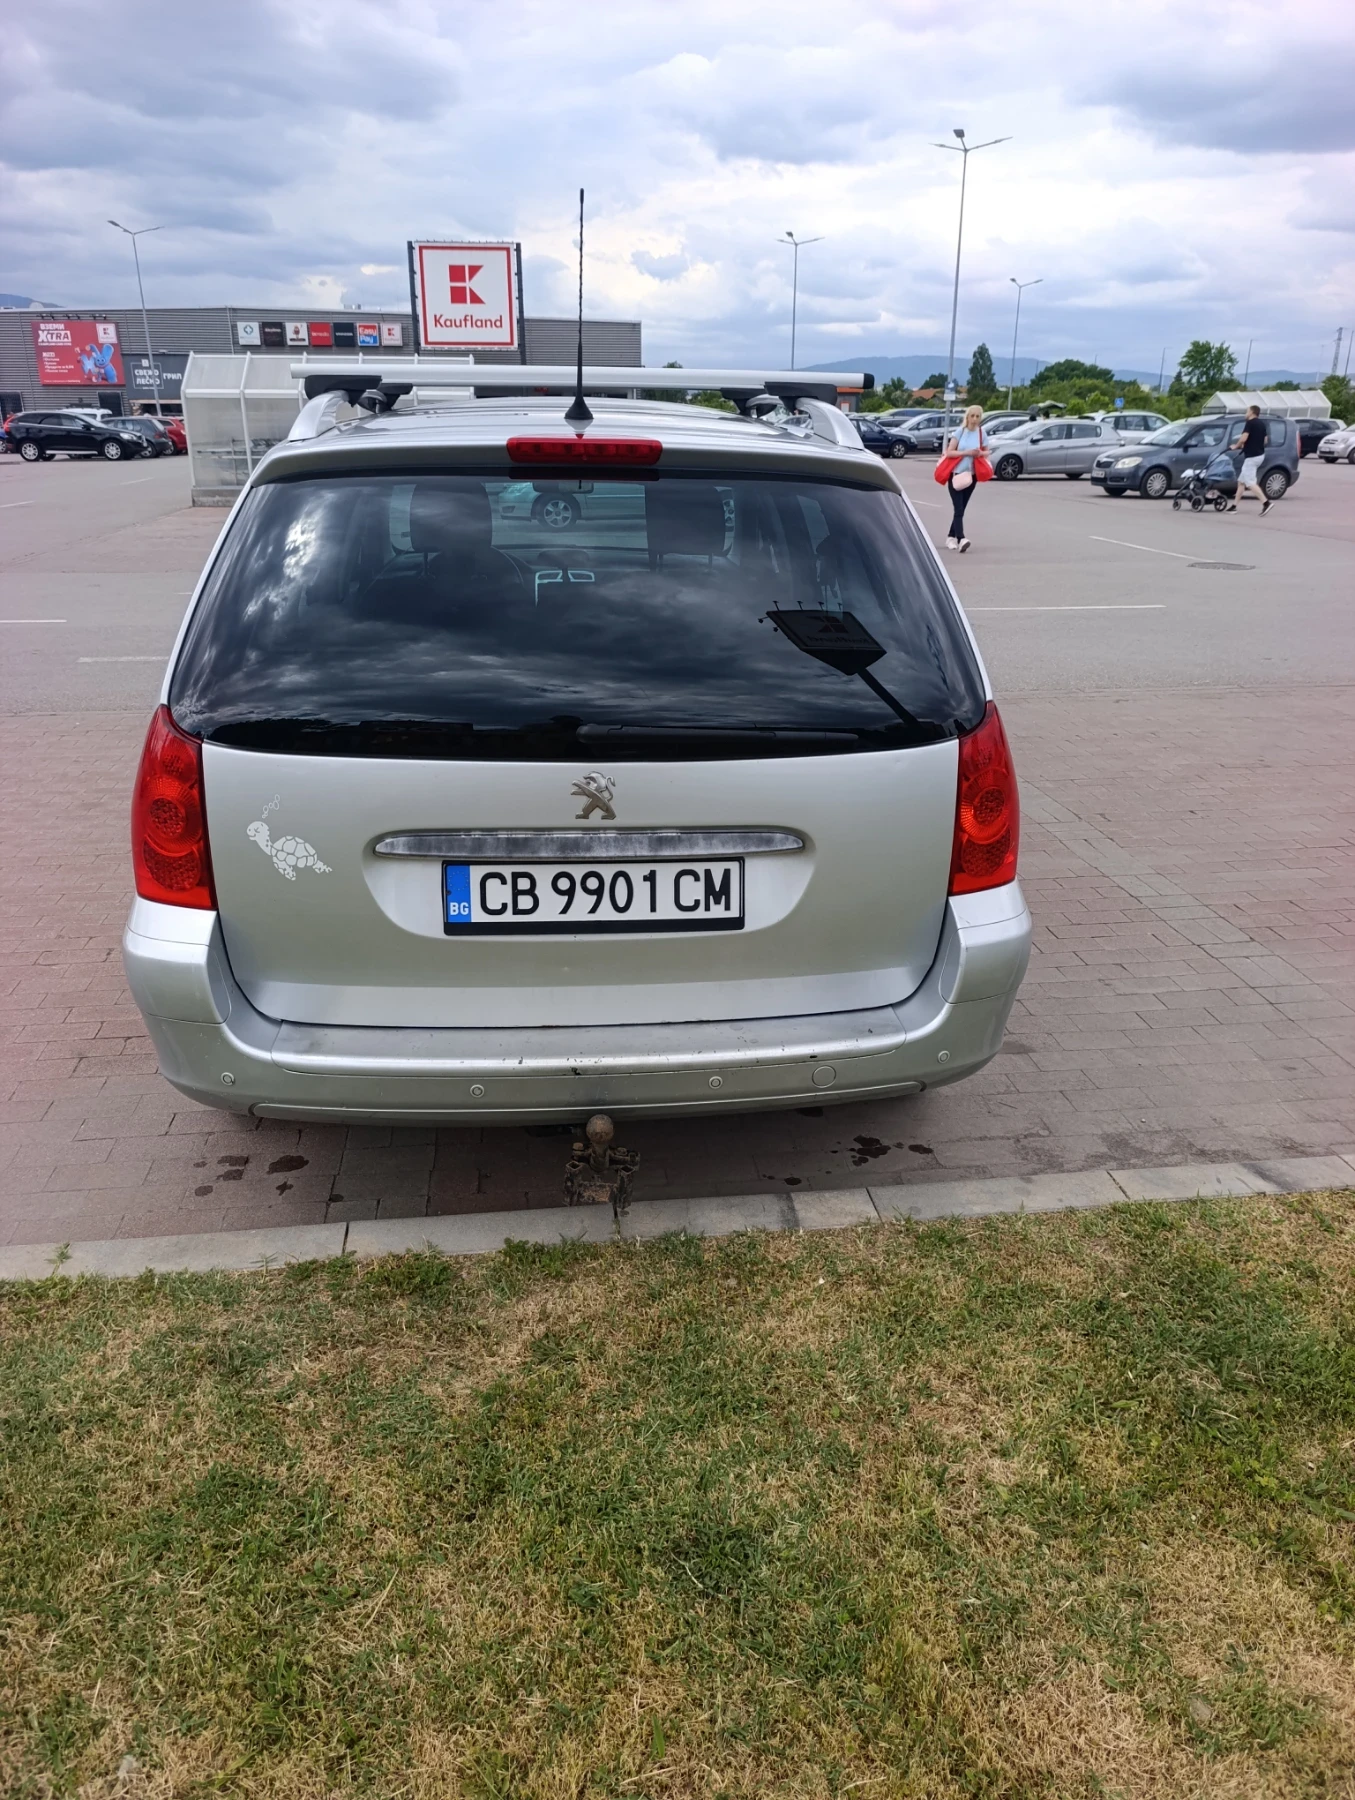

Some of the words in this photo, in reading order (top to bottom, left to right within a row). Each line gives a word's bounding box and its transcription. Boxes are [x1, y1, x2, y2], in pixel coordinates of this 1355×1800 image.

[433, 314, 503, 328] Kaufland
[38, 330, 72, 342] XTRA
[359, 327, 377, 336] Easy
[360, 335, 374, 344] Pay
[479, 871, 540, 916] CB
[551, 869, 658, 915] 9901
[673, 868, 732, 912] CM
[449, 902, 470, 915] BG
